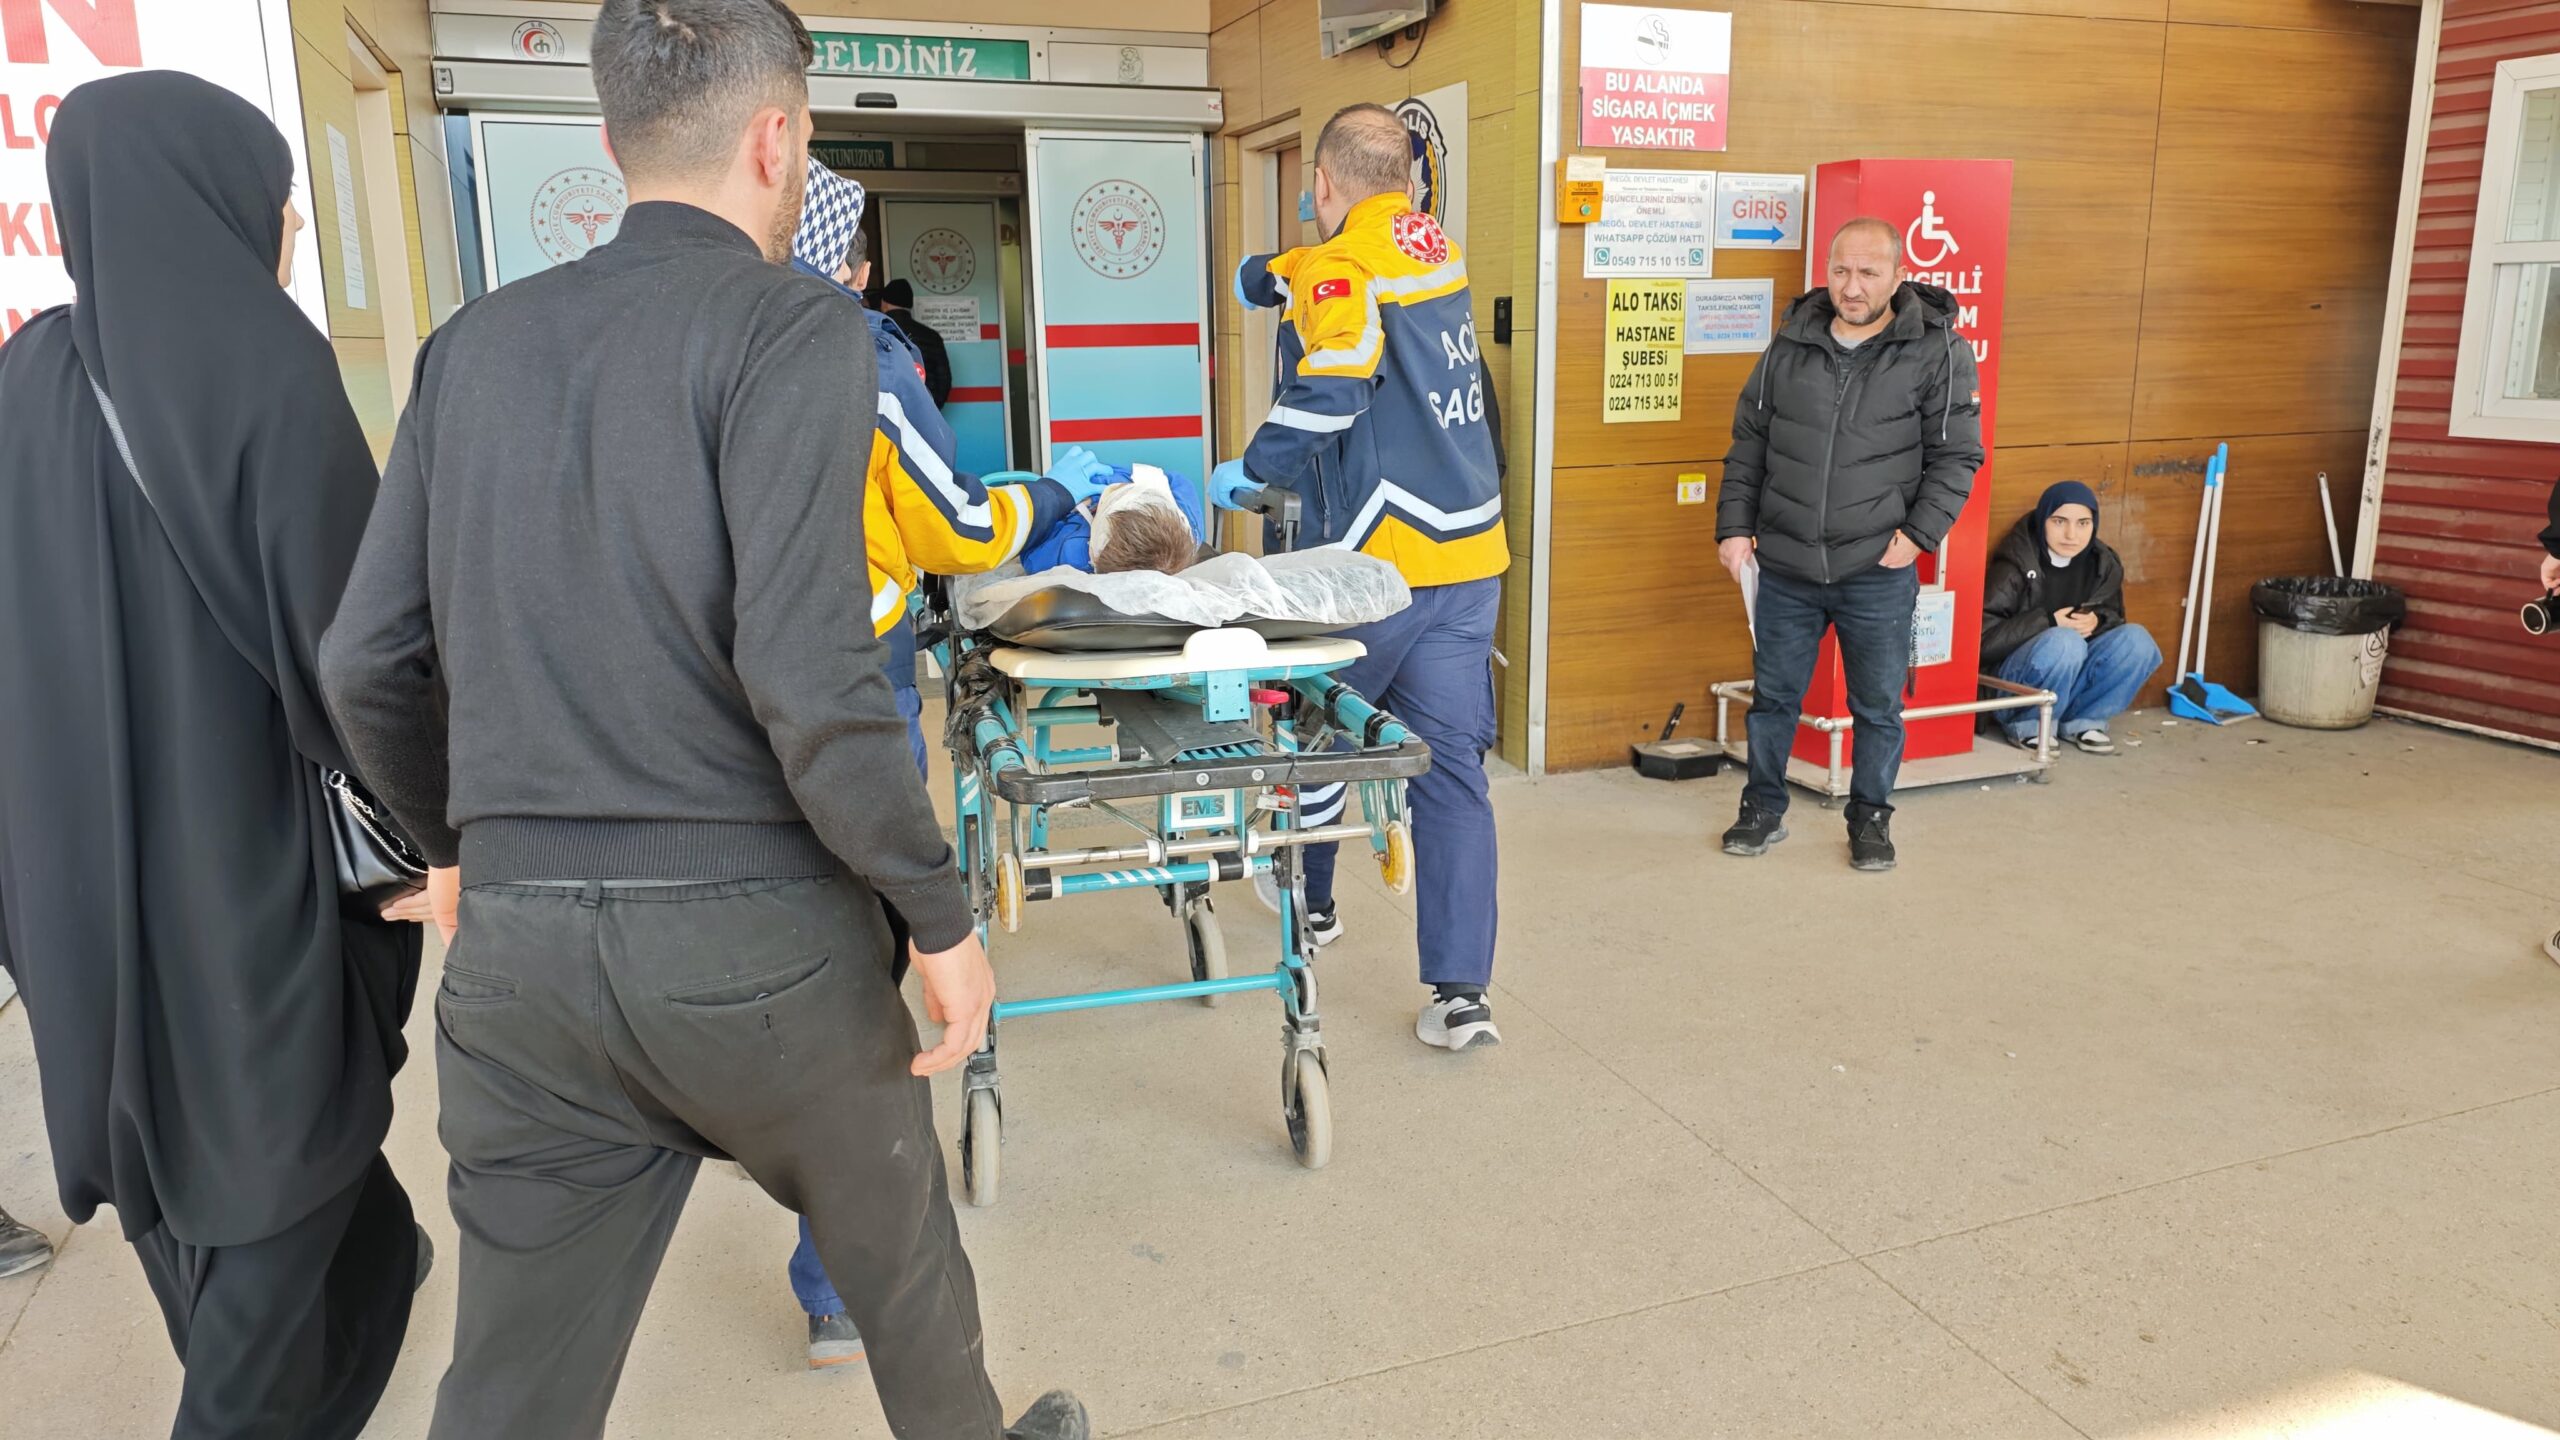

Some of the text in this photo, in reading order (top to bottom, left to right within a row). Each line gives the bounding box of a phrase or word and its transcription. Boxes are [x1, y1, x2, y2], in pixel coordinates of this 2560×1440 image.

[1605, 72, 1705, 95] BU ALANDA
[1592, 95, 1715, 125] SİGARA İÇMEK
[1401, 111, 1428, 139] LİS
[1611, 126, 1695, 147] YASAKTIR
[1603, 193, 1665, 205] ÜŞÜNCELERİNİZ
[1636, 206, 1665, 216] ÖNEMLİ
[1732, 195, 1787, 224] GİRİŞ
[1628, 220, 1657, 228] DEVLET
[1594, 232, 1704, 245] WHATSAPP ÇÖZÜM HATTI
[1612, 256, 1686, 267] 0549 715 10 15
[1903, 265, 1982, 294] GELLİ
[1612, 292, 1639, 312] ALO
[1441, 311, 1480, 370] ACİ
[1616, 326, 1676, 342] HASTANE
[1610, 372, 1679, 388] 0224 713 00 51
[1609, 395, 1678, 411] 0224 715 34 34
[1182, 798, 1224, 816] EMS
